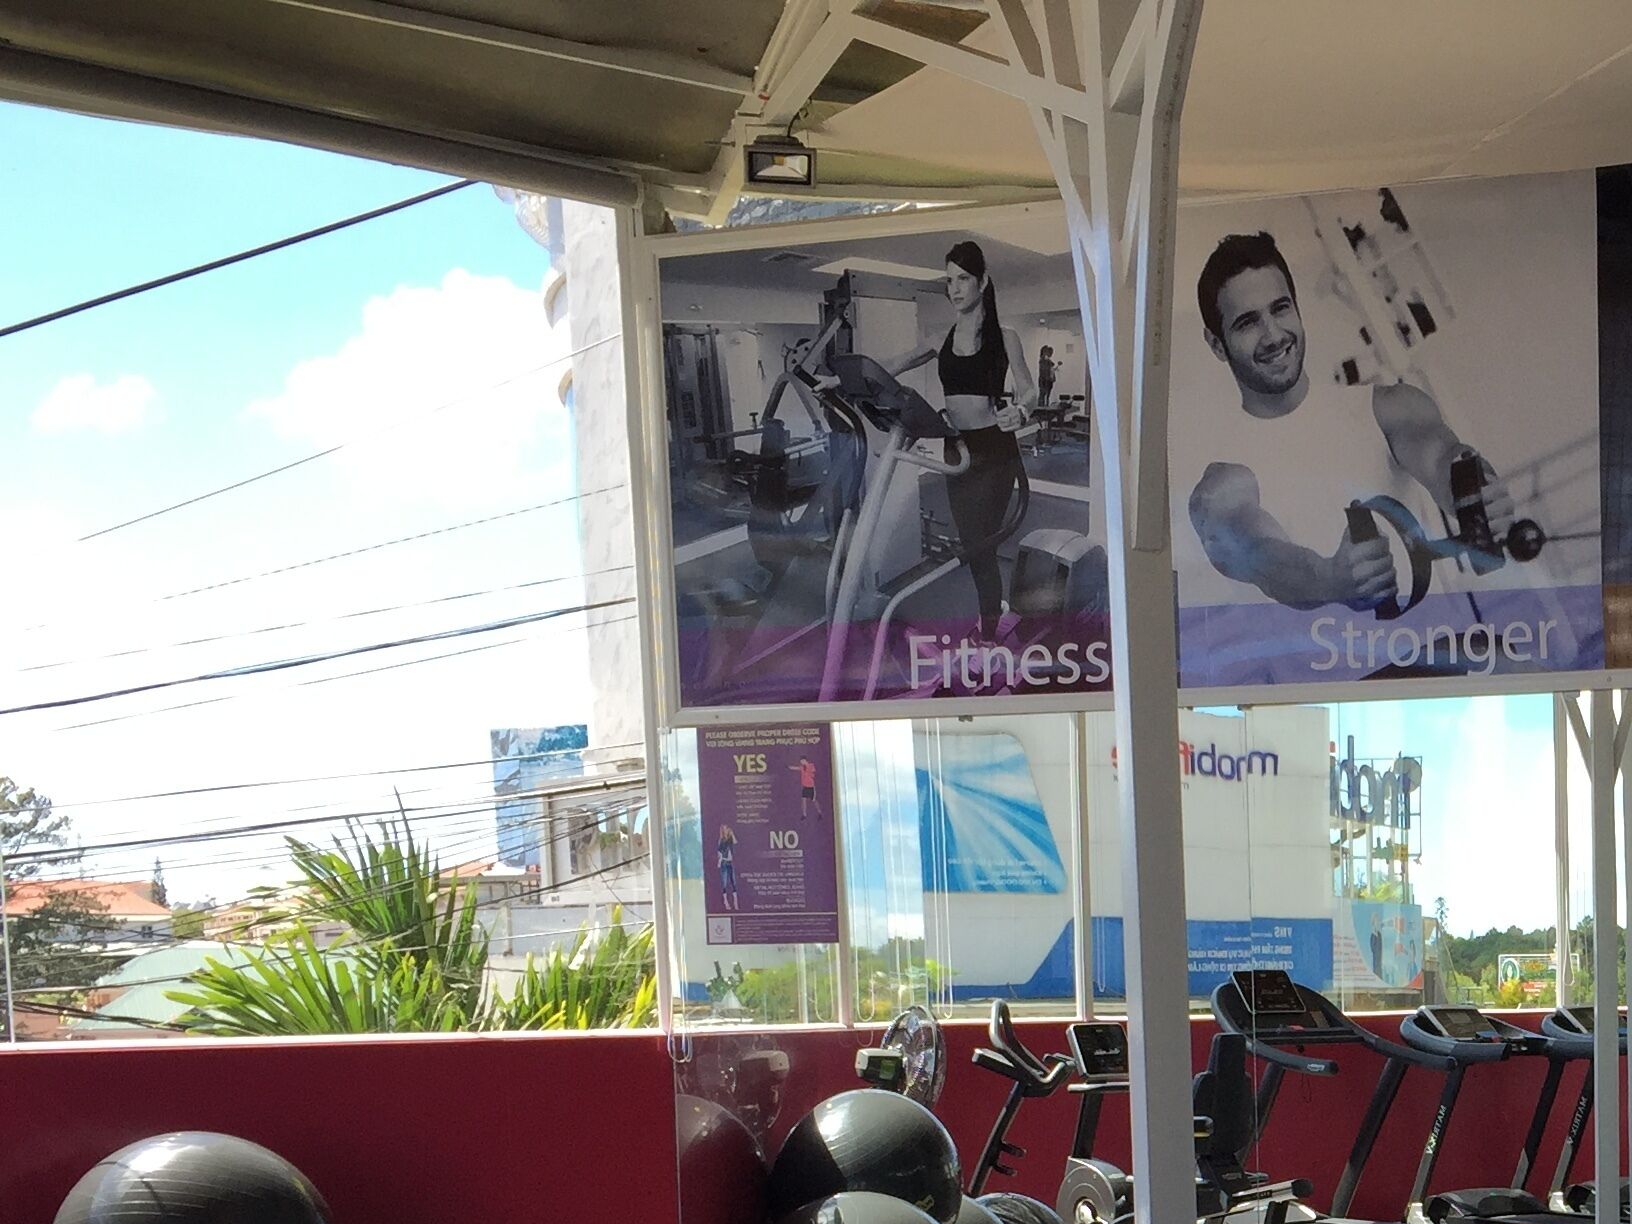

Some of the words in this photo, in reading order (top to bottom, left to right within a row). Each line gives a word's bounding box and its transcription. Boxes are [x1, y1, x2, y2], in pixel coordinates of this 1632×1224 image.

[908, 632, 1110, 690] Fitness
[1309, 615, 1557, 675] Stronger
[733, 753, 767, 773] YES
[770, 830, 799, 849] NO
